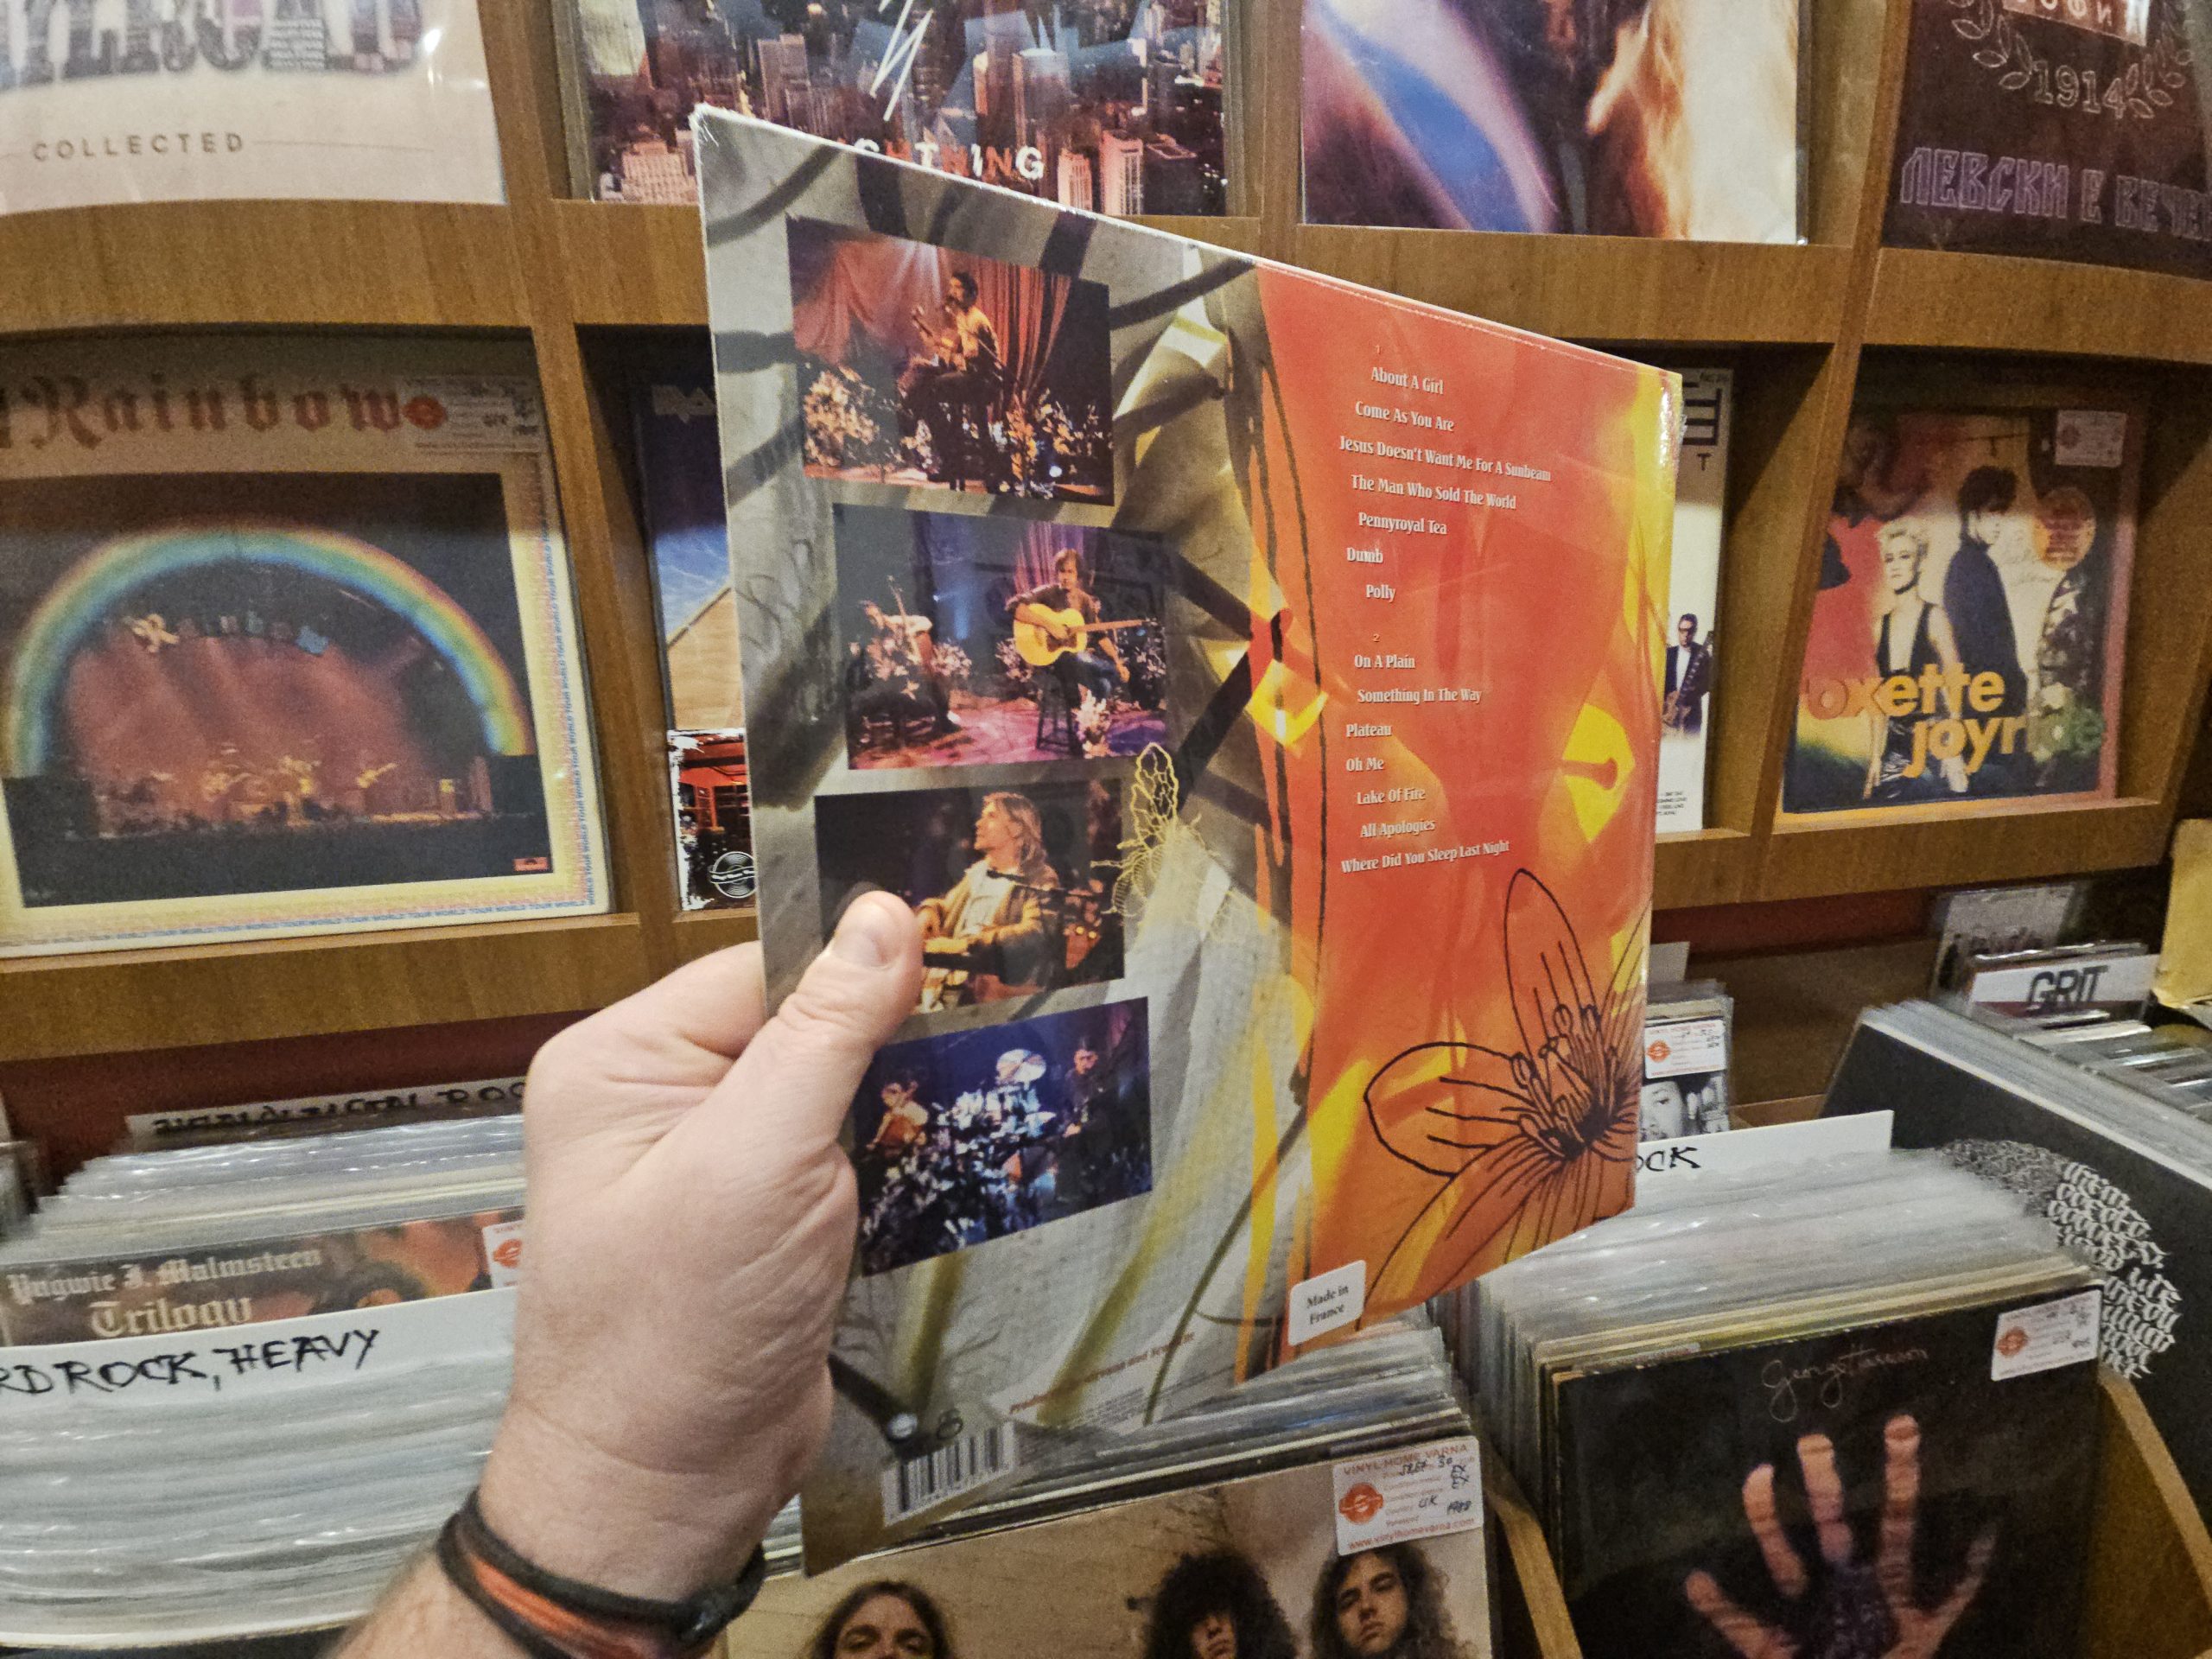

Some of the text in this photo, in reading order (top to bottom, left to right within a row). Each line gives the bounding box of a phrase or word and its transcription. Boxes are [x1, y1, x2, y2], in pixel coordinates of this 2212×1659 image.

[2031, 59, 2126, 118] 1914
[33, 132, 244, 162] COLLECTED
[1900, 146, 2070, 219] ЛЕВСКИ
[1372, 367, 1444, 394] About A Girl
[1356, 401, 1454, 431] Come As You Are
[1339, 435, 1551, 481] Jesus Doesn't Want Me For A Sunbeam
[1351, 474, 1516, 509] The Man Who Sold The World
[1358, 512, 1447, 534] Pennyroyal Tea
[1347, 547, 1383, 563] Dumb
[1366, 585, 1396, 602] Polly
[1373, 633, 1380, 642] 2
[1355, 655, 1415, 669] On A Plain
[1357, 689, 1482, 705] Something In The Way
[1346, 724, 1392, 737] Plateau
[1346, 758, 1384, 772] Oh Me
[1357, 787, 1426, 804] Lake Of Fire
[1360, 819, 1436, 838] All Apologies
[1341, 840, 1510, 874] Where Did You Sleep Last Night
[1307, 1285, 1349, 1309] Made in
[1310, 1304, 1344, 1325] France
[213, 1328, 380, 1375] HEAVY
